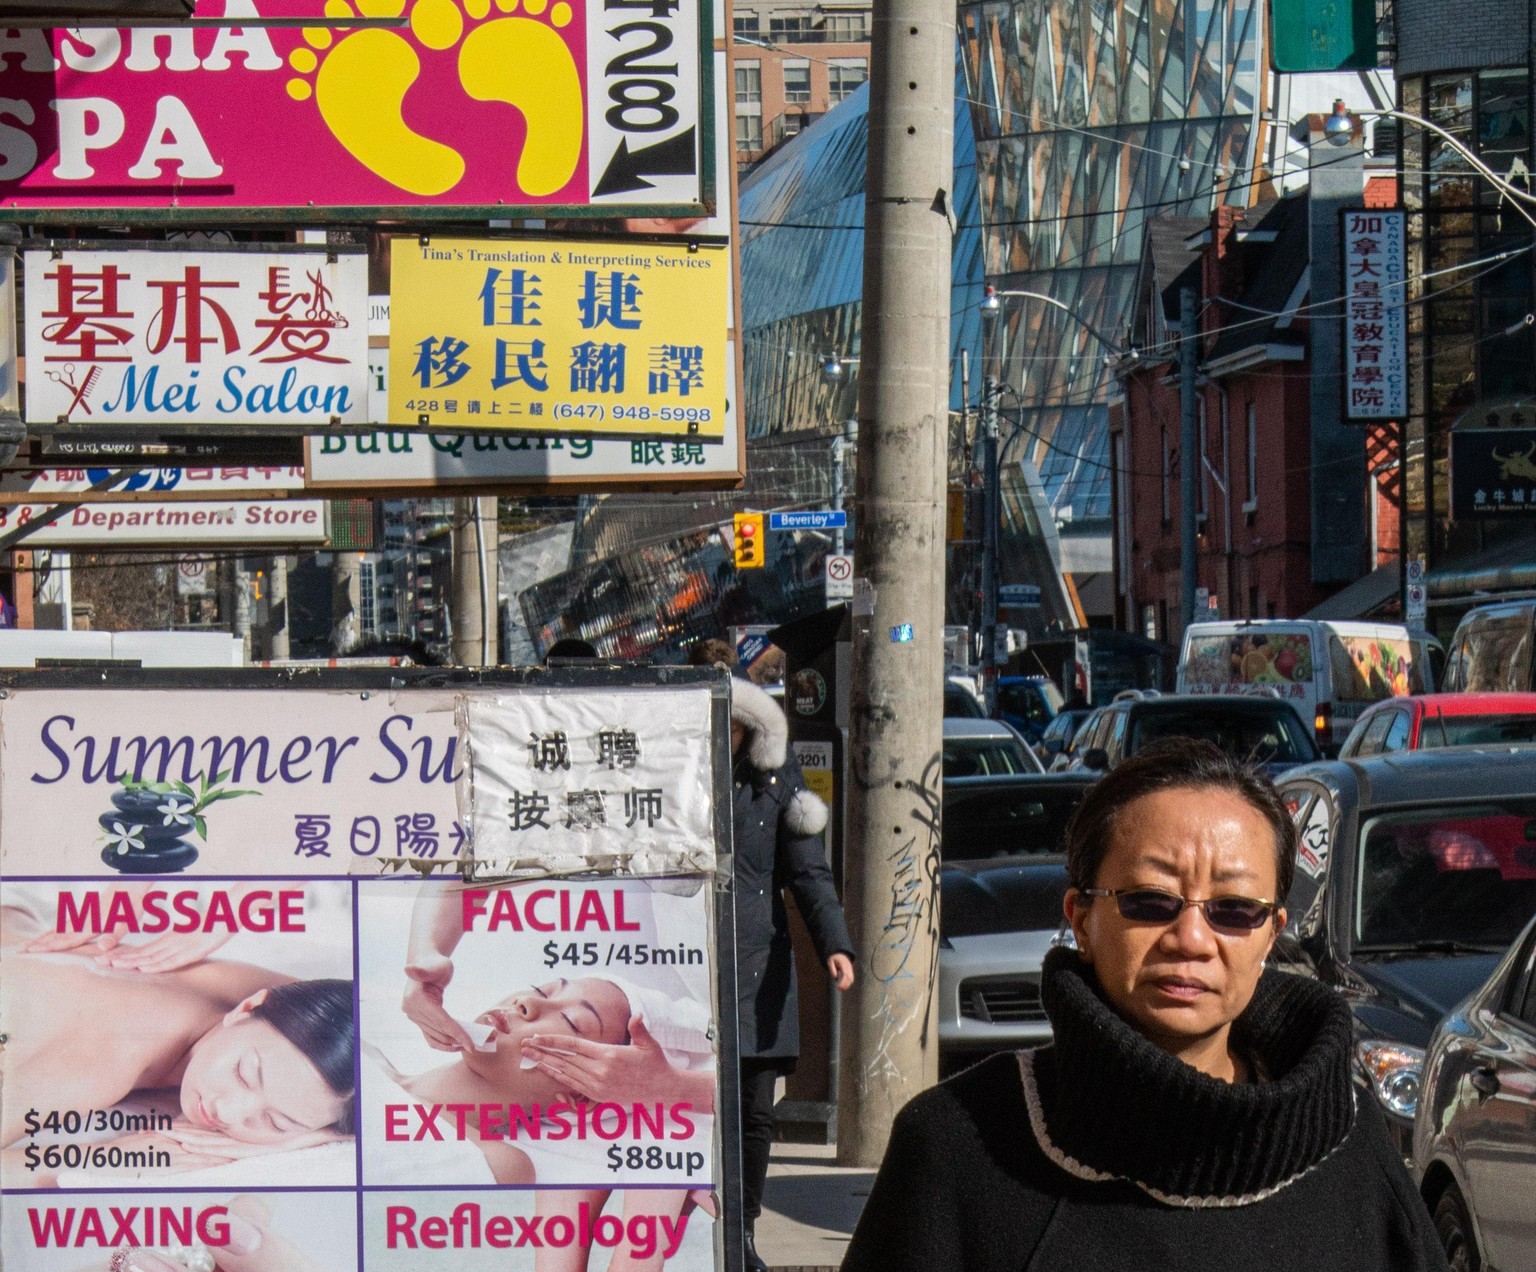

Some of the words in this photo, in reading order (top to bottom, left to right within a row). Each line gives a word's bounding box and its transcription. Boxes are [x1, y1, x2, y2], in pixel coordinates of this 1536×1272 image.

[0, 95, 224, 181] SPA
[420, 247, 464, 262] Tina's
[467, 249, 547, 264] Translation
[550, 252, 563, 264] &
[567, 252, 651, 270] Interpreting
[655, 254, 711, 269] Services
[477, 267, 644, 330] 佳捷
[411, 335, 705, 397] 移民翻譯
[102, 364, 202, 413] Mei
[215, 365, 353, 414] Salon
[553, 403, 606, 422] (647)
[612, 405, 711, 423] 948-5998
[72, 507, 236, 531] Department
[245, 505, 318, 526] Store
[781, 513, 828, 528] Beverley
[31, 714, 360, 786] Summer
[526, 729, 641, 773] 诚聘
[55, 889, 307, 934] MASSAGE
[460, 888, 641, 933] FACIAL
[542, 940, 599, 969] $45
[605, 942, 704, 968] /45min
[23, 1108, 174, 1137] $40/30min
[384, 1101, 696, 1143] EXTENSIONS
[23, 1143, 172, 1172] $60/60min
[606, 1143, 705, 1175] $88up
[27, 1205, 232, 1249] WAXING
[386, 1201, 690, 1262] Reflexology
